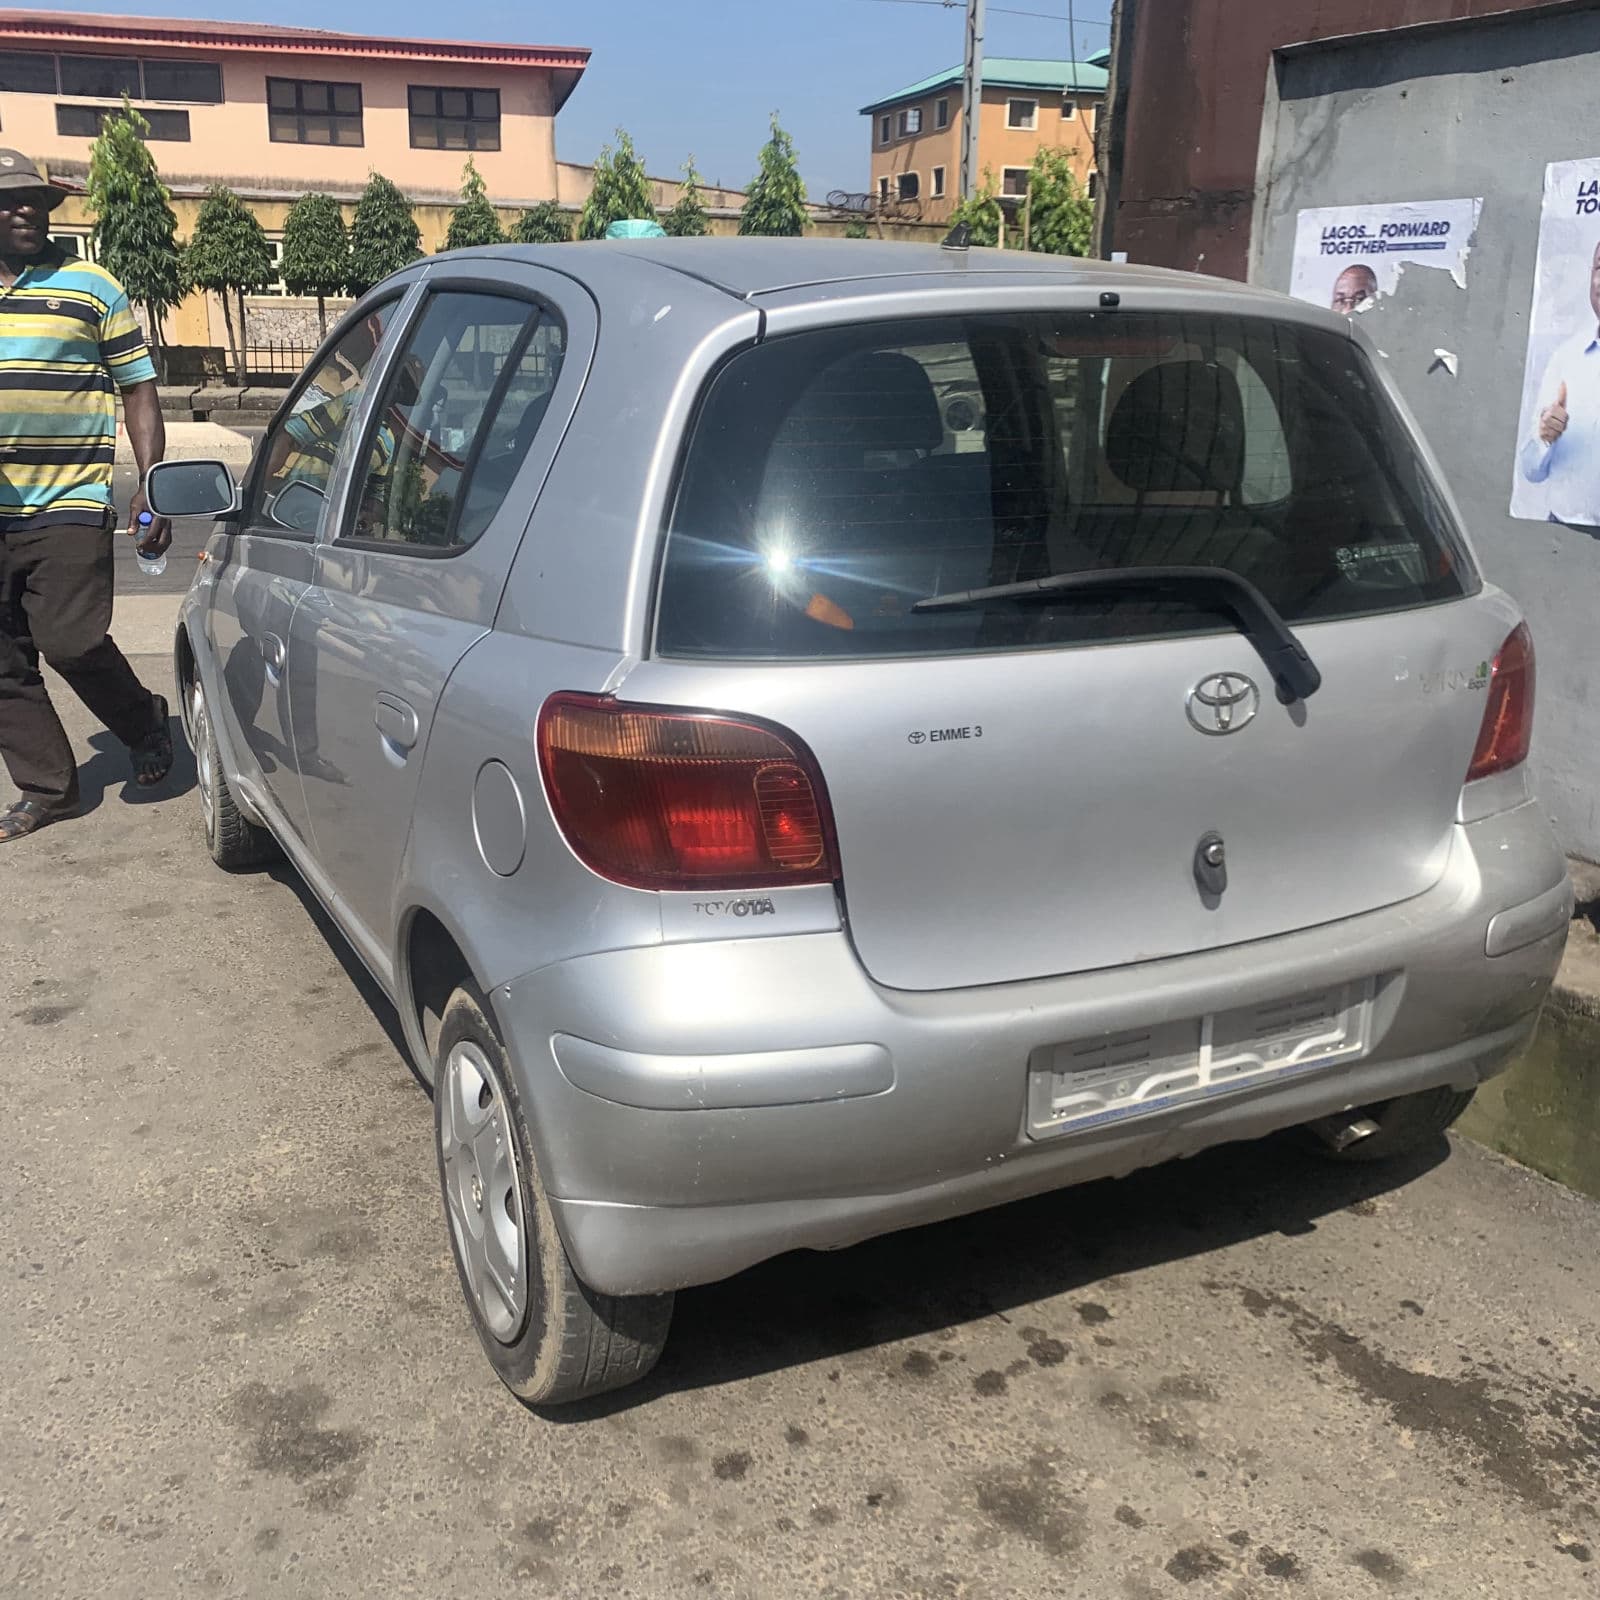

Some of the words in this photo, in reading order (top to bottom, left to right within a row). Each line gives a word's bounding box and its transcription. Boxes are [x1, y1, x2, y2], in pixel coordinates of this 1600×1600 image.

[1577, 180, 1600, 197] LA
[1576, 198, 1600, 215] TO
[1379, 221, 1450, 238] FORWARD
[1320, 240, 1386, 255] TOGETHER
[930, 727, 971, 742] EMME
[974, 725, 983, 738] 3
